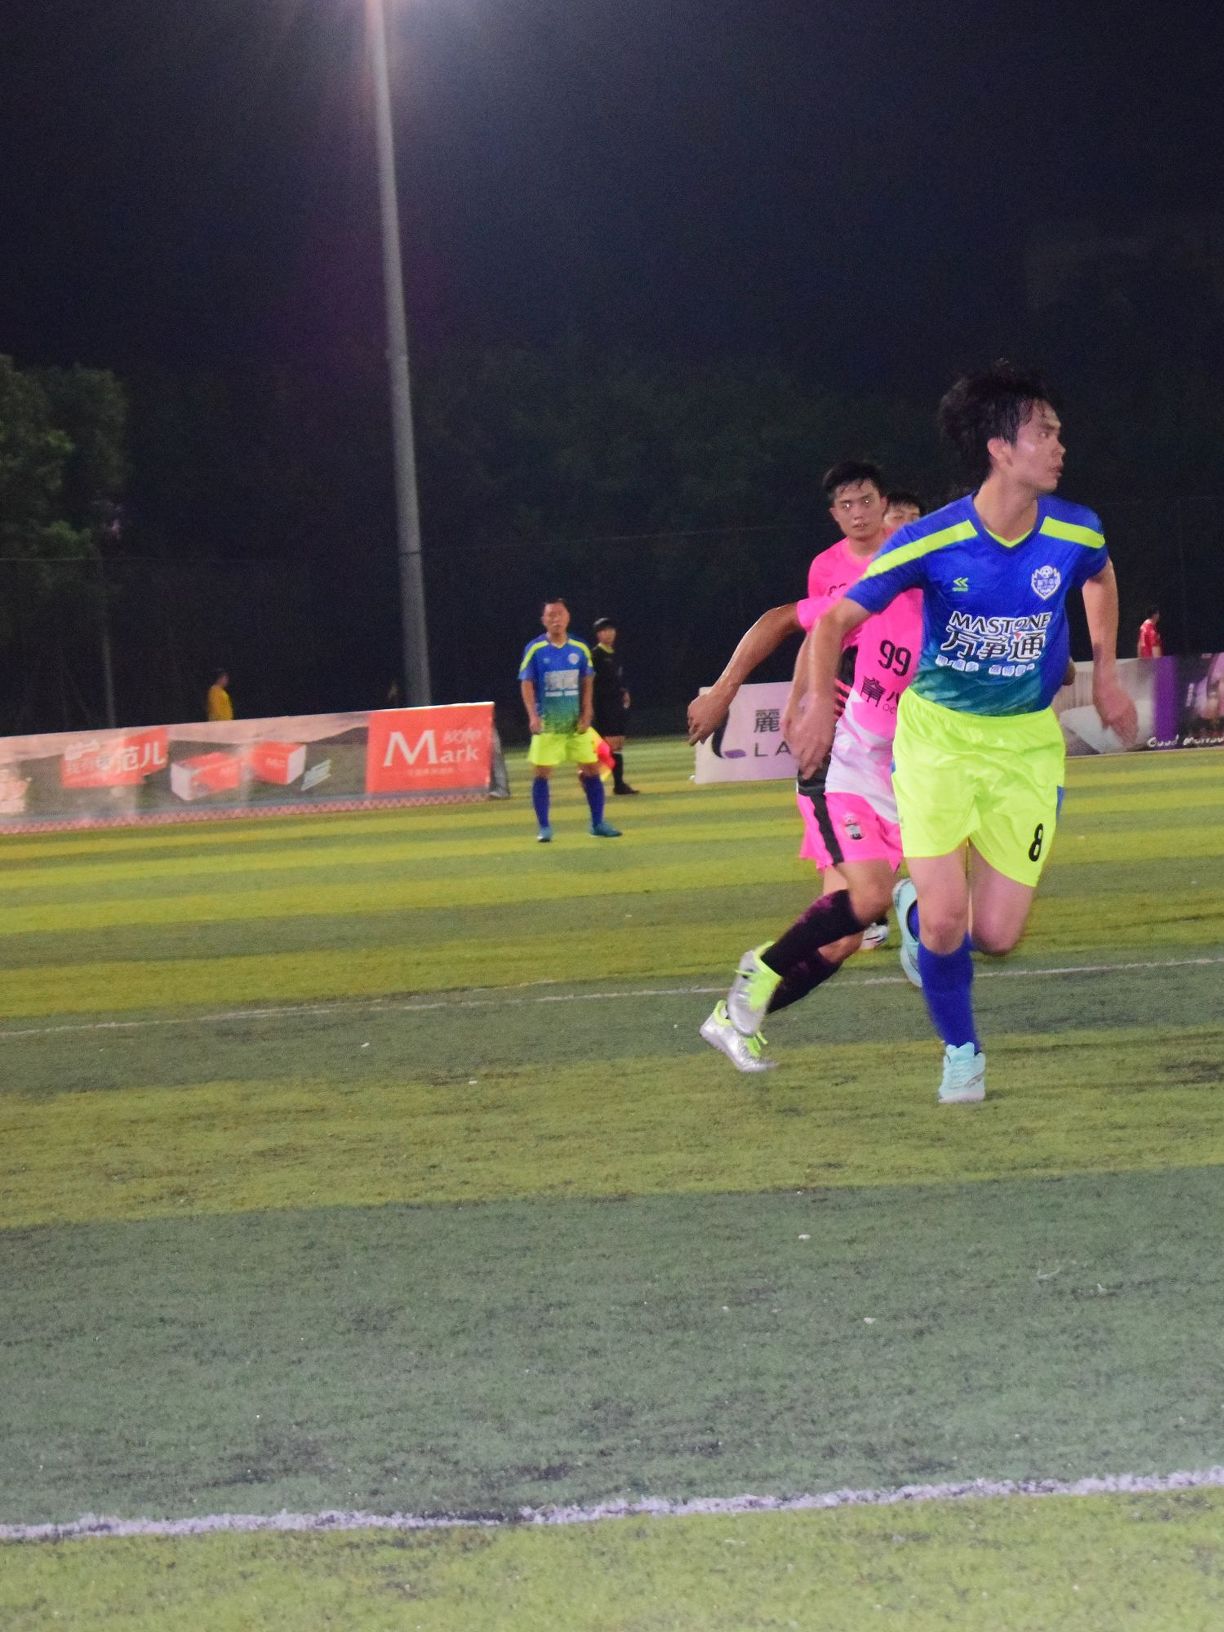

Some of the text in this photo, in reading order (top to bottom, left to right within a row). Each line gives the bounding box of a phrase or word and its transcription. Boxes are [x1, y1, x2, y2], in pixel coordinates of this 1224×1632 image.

[949, 610, 1052, 636] MASTONE
[878, 639, 912, 677] 99
[383, 729, 479, 767] Mark
[1028, 823, 1044, 862] 8
